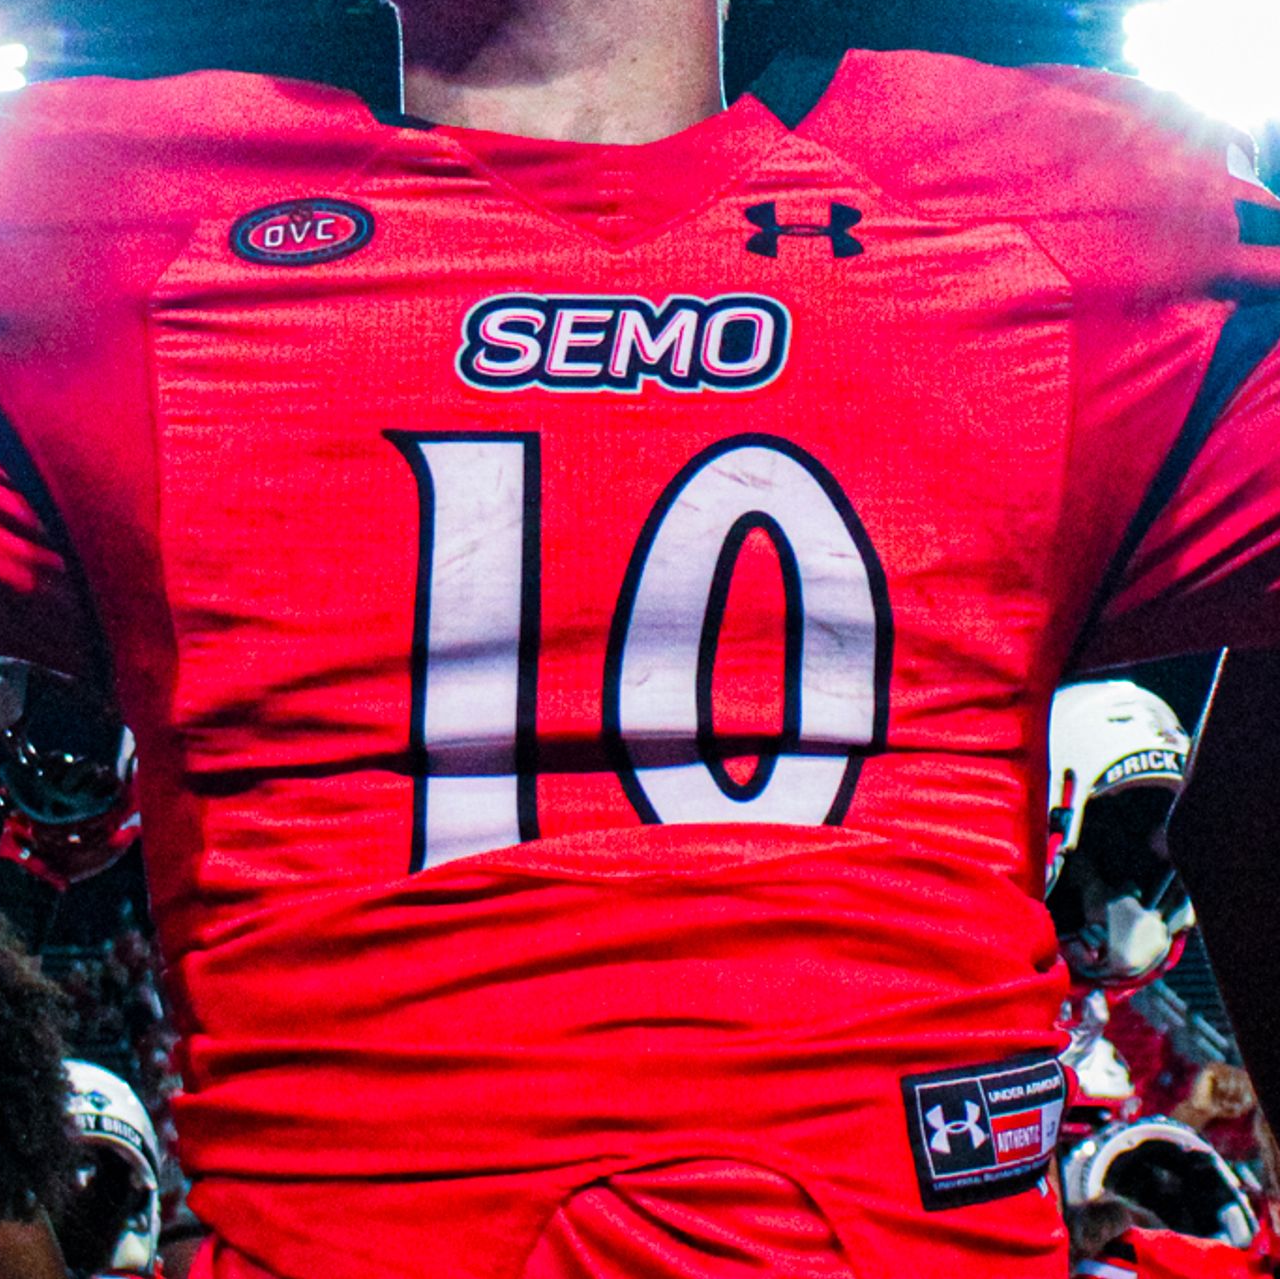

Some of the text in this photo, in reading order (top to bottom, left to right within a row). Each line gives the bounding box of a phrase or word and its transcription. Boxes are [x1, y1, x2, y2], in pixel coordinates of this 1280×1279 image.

[264, 218, 336, 247] OVC
[468, 303, 778, 381] SEMO
[382, 430, 895, 875] 10
[1106, 750, 1180, 783] BRICK
[988, 1075, 1062, 1103] UNDER ARMOUR
[996, 1123, 1041, 1153] AUTHENTIC
